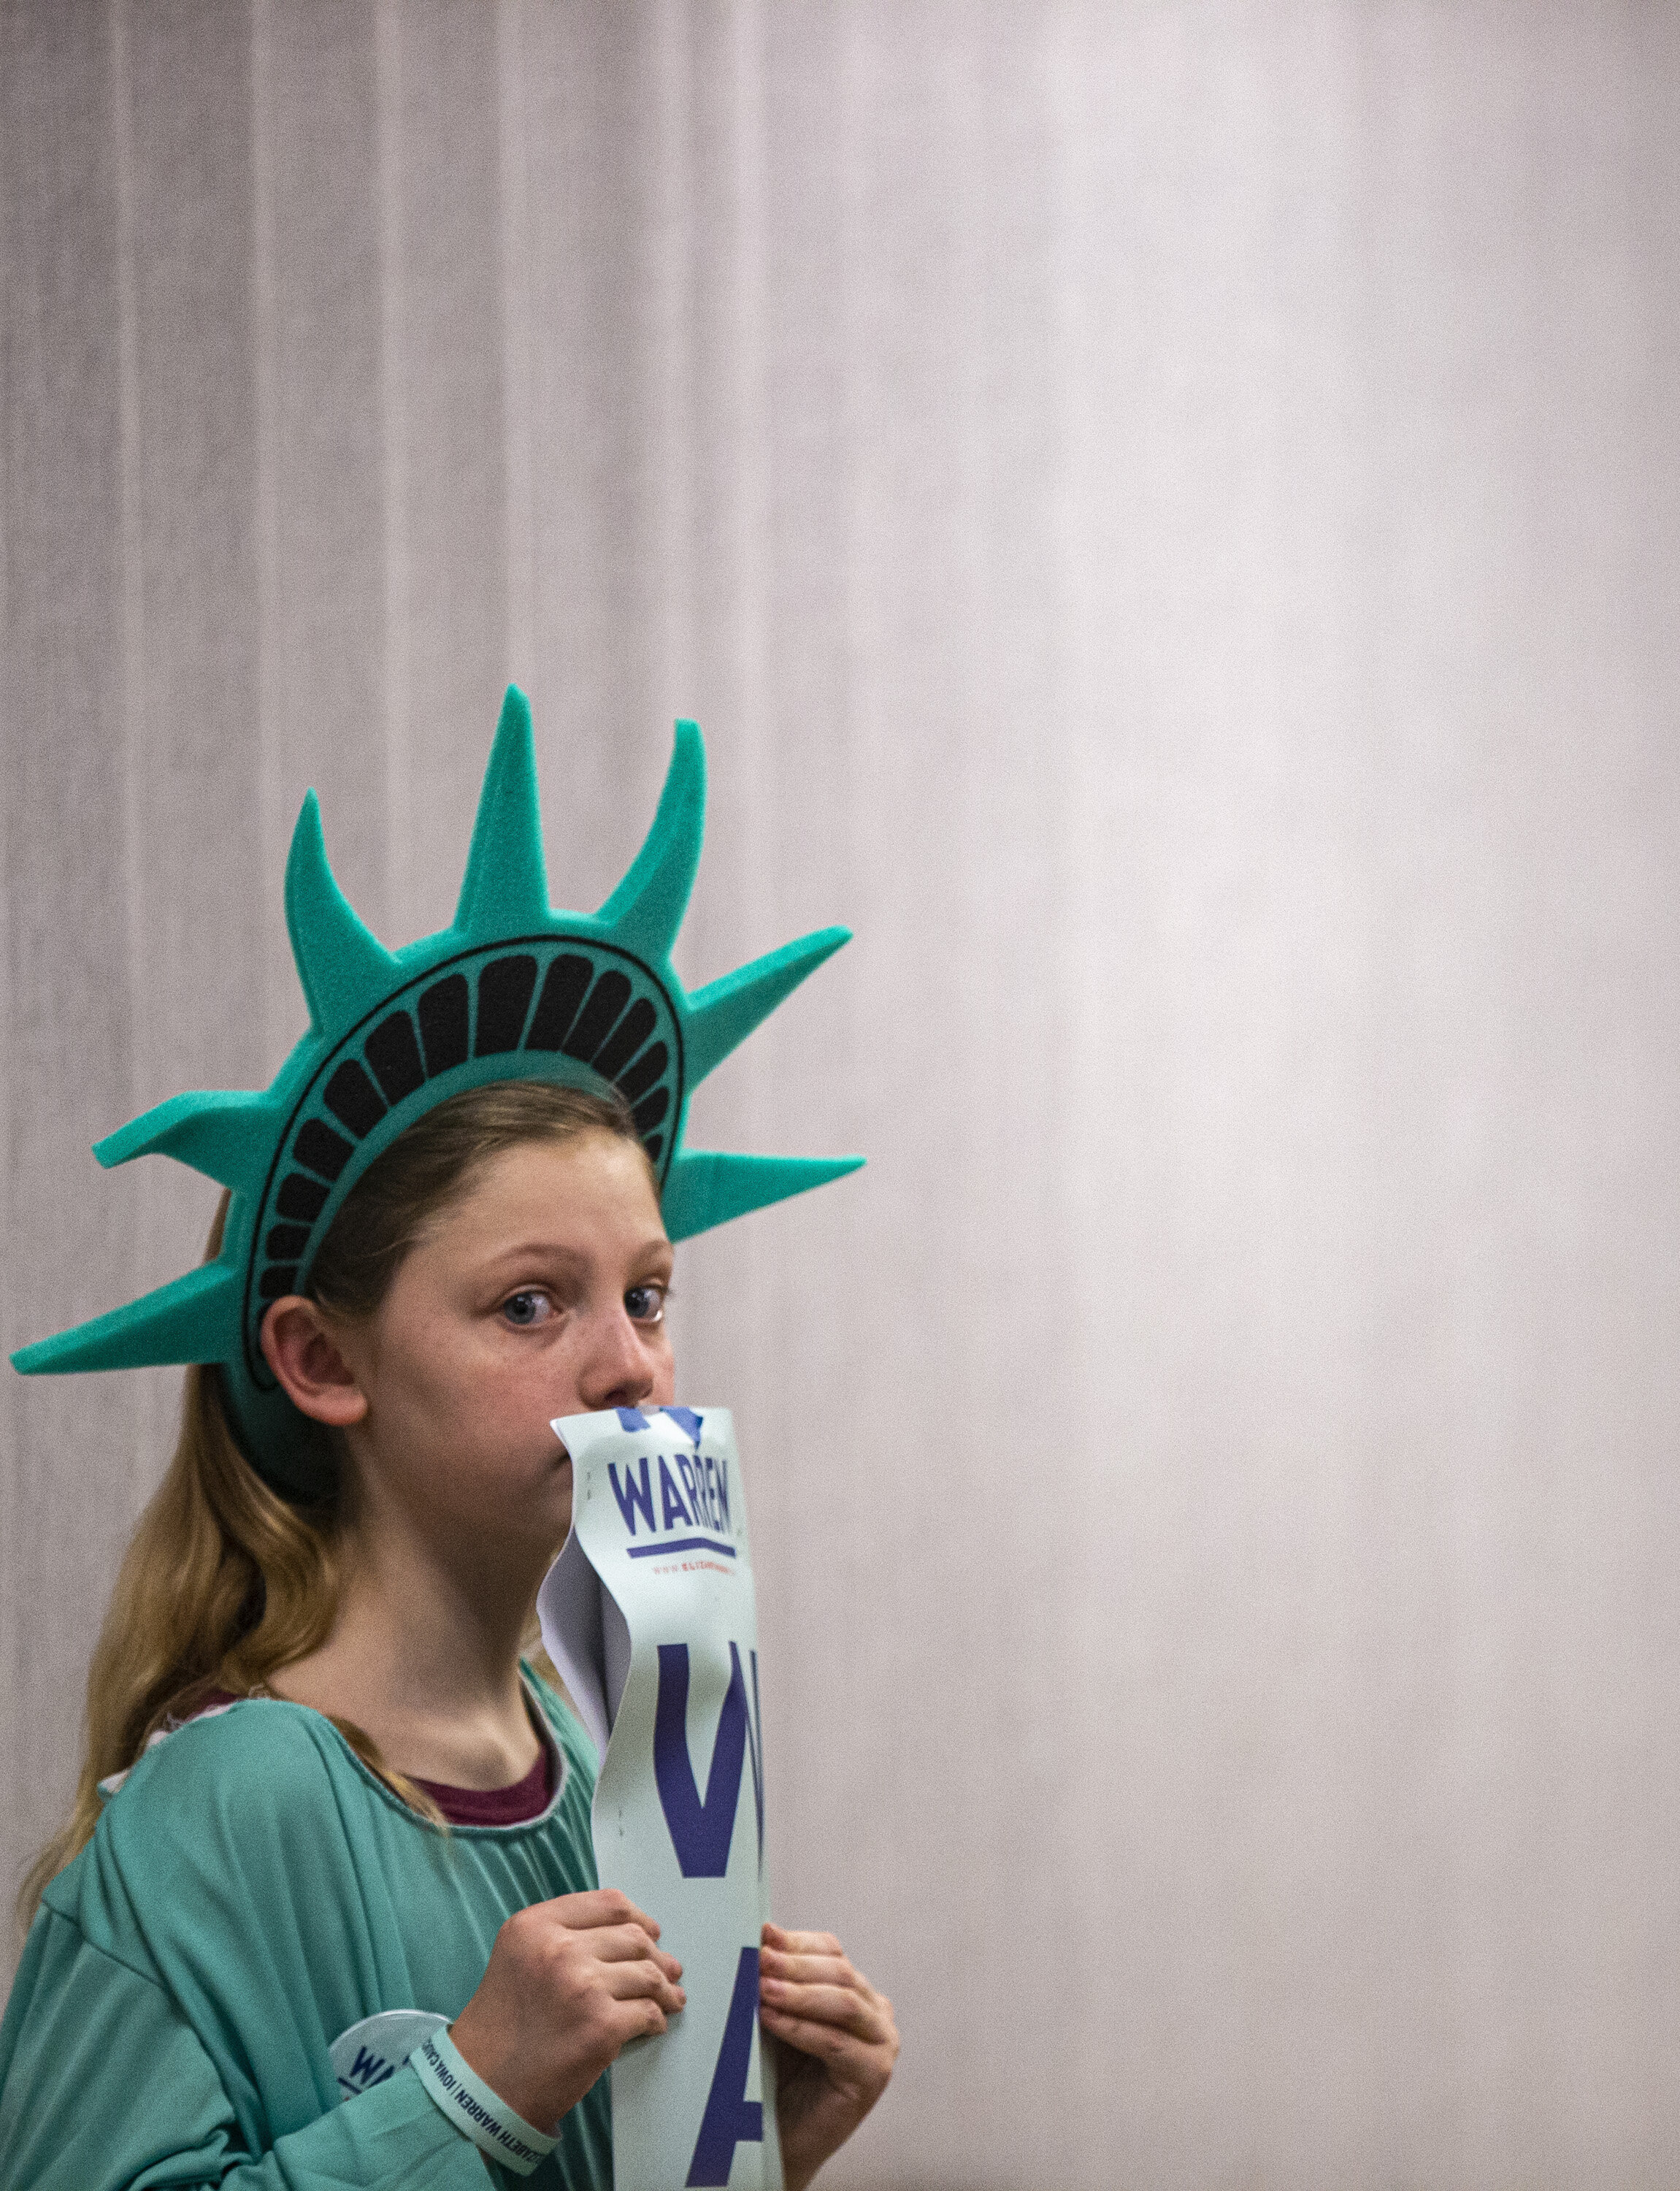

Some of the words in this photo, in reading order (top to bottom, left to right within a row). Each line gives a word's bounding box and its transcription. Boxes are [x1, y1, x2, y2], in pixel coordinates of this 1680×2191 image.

[607, 1454, 731, 1536] WARREN
[434, 2060, 457, 2091] IOWA
[454, 2089, 502, 2138] WARREN
